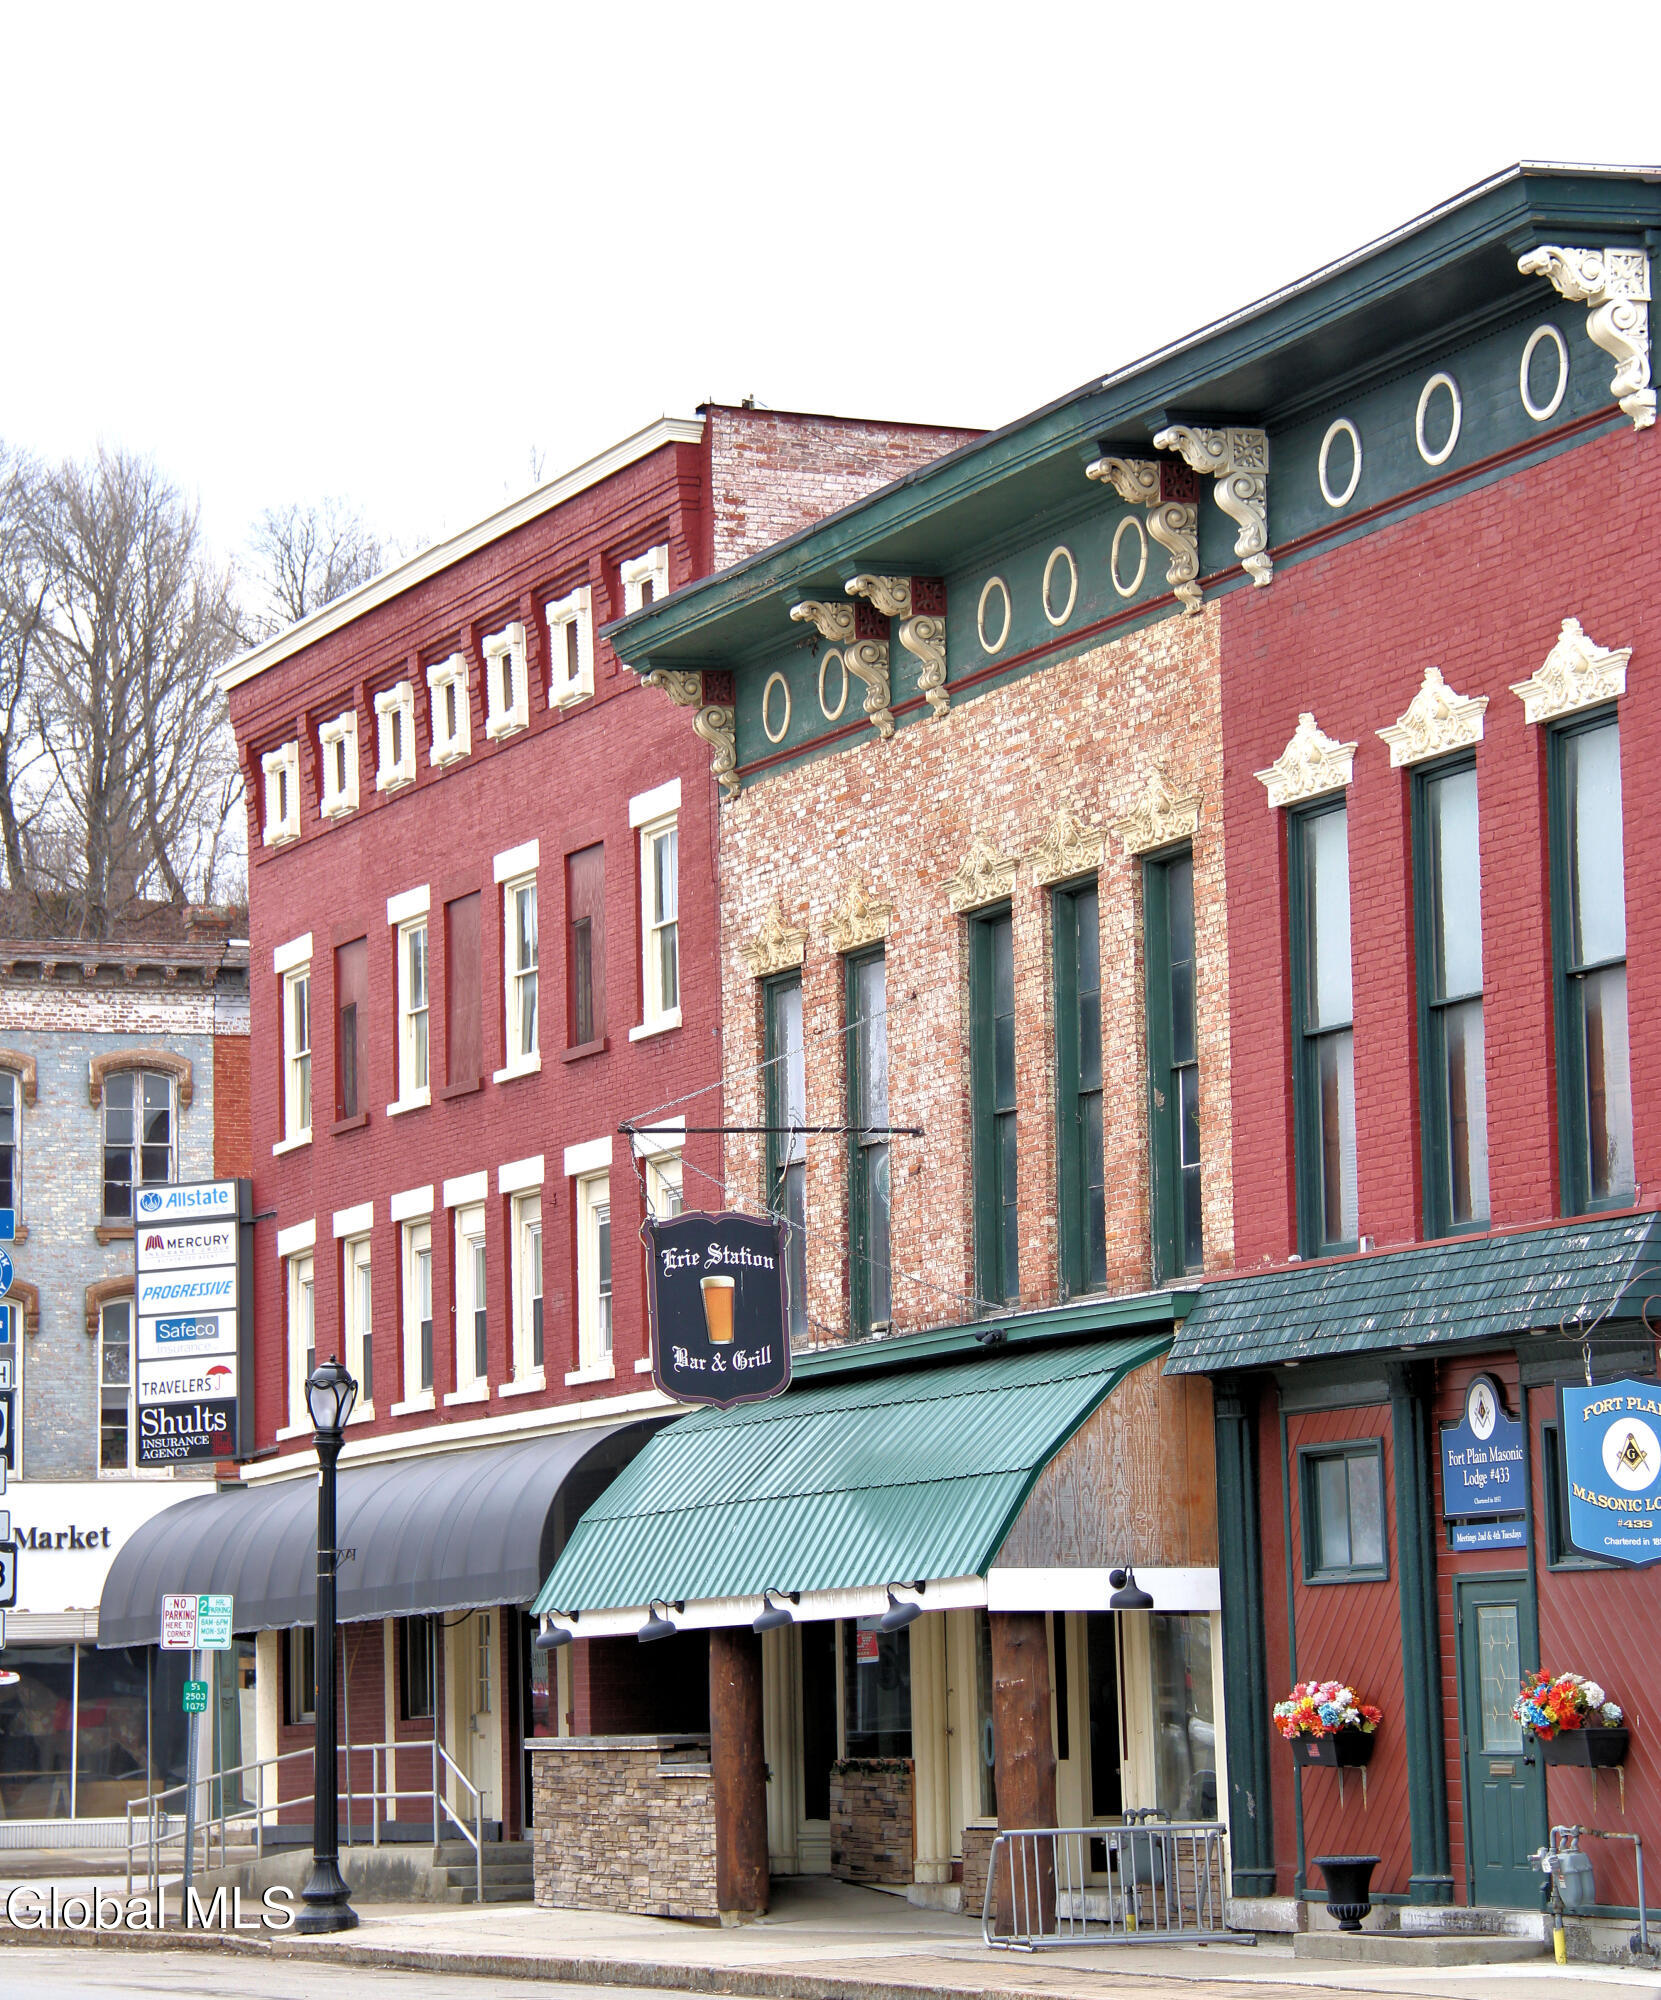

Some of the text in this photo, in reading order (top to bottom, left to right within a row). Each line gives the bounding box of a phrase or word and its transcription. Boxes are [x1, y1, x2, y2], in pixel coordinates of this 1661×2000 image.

[166, 1187, 228, 1208] Allstate
[167, 1234, 229, 1249] MERCURY
[661, 1242, 775, 1278] Erie Station
[142, 1280, 233, 1300] PROGRESSIVE
[160, 1322, 215, 1339] Safeco
[672, 1344, 772, 1373] Bar & Grill
[142, 1378, 211, 1396] TRAVELERS
[1583, 1397, 1623, 1422] FORT
[141, 1405, 227, 1437] Shults
[142, 1435, 210, 1449] INSURANCE
[142, 1447, 190, 1460] AGENCY
[1448, 1444, 1523, 1466] Fort Plain Masonic
[1463, 1466, 1510, 1489] Lodge #433
[1572, 1482, 1642, 1513] MASONIC
[1617, 1518, 1653, 1529] #433
[14, 1525, 111, 1550] Market
[1604, 1536, 1641, 1546] Chartered
[1643, 1538, 1650, 1546] in
[173, 1599, 187, 1609] NO
[200, 1600, 208, 1614] 2
[165, 1610, 195, 1621] PARKING
[165, 1621, 193, 1630] HERE TO
[167, 1630, 191, 1638] CORNER
[186, 1693, 206, 1701] 2503
